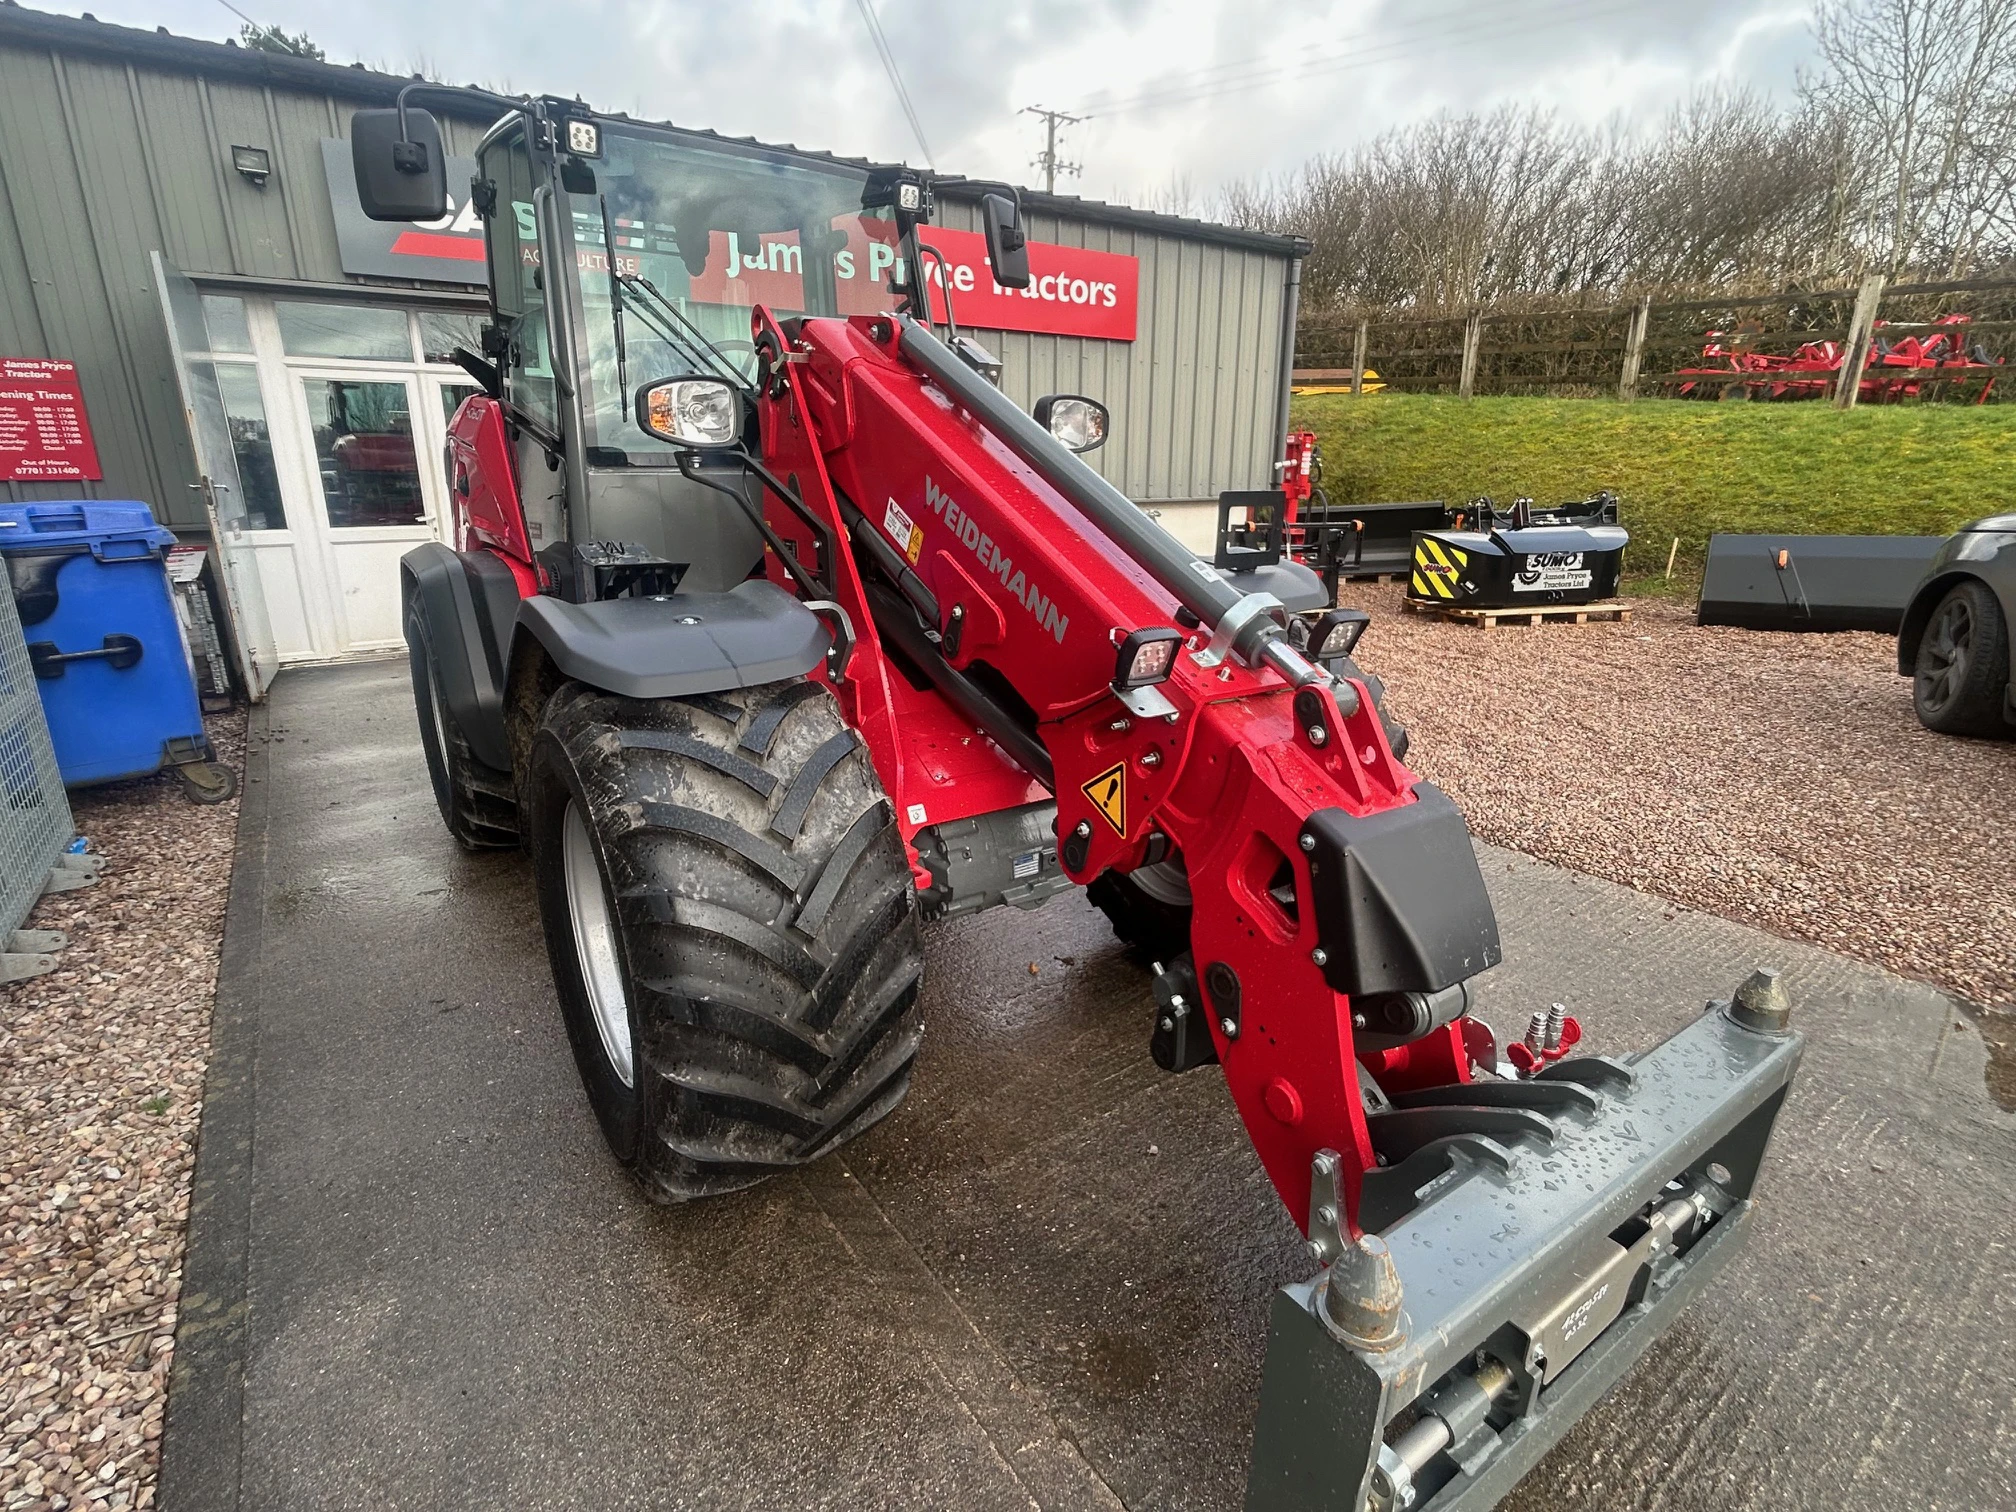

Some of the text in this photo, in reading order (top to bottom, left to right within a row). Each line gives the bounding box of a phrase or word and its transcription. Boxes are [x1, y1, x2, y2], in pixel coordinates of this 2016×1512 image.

[522, 248, 635, 272] AULTURE
[726, 232, 856, 279] Jams
[869, 242, 975, 292] Prce
[984, 257, 1116, 308] actors
[3, 360, 73, 371] James Pryce
[5, 370, 52, 378] Tractors
[0, 390, 74, 401] ening Times
[926, 474, 1069, 645] WEIDEMANN
[1530, 552, 1578, 567] SUMO
[1567, 572, 1586, 581] Pryce
